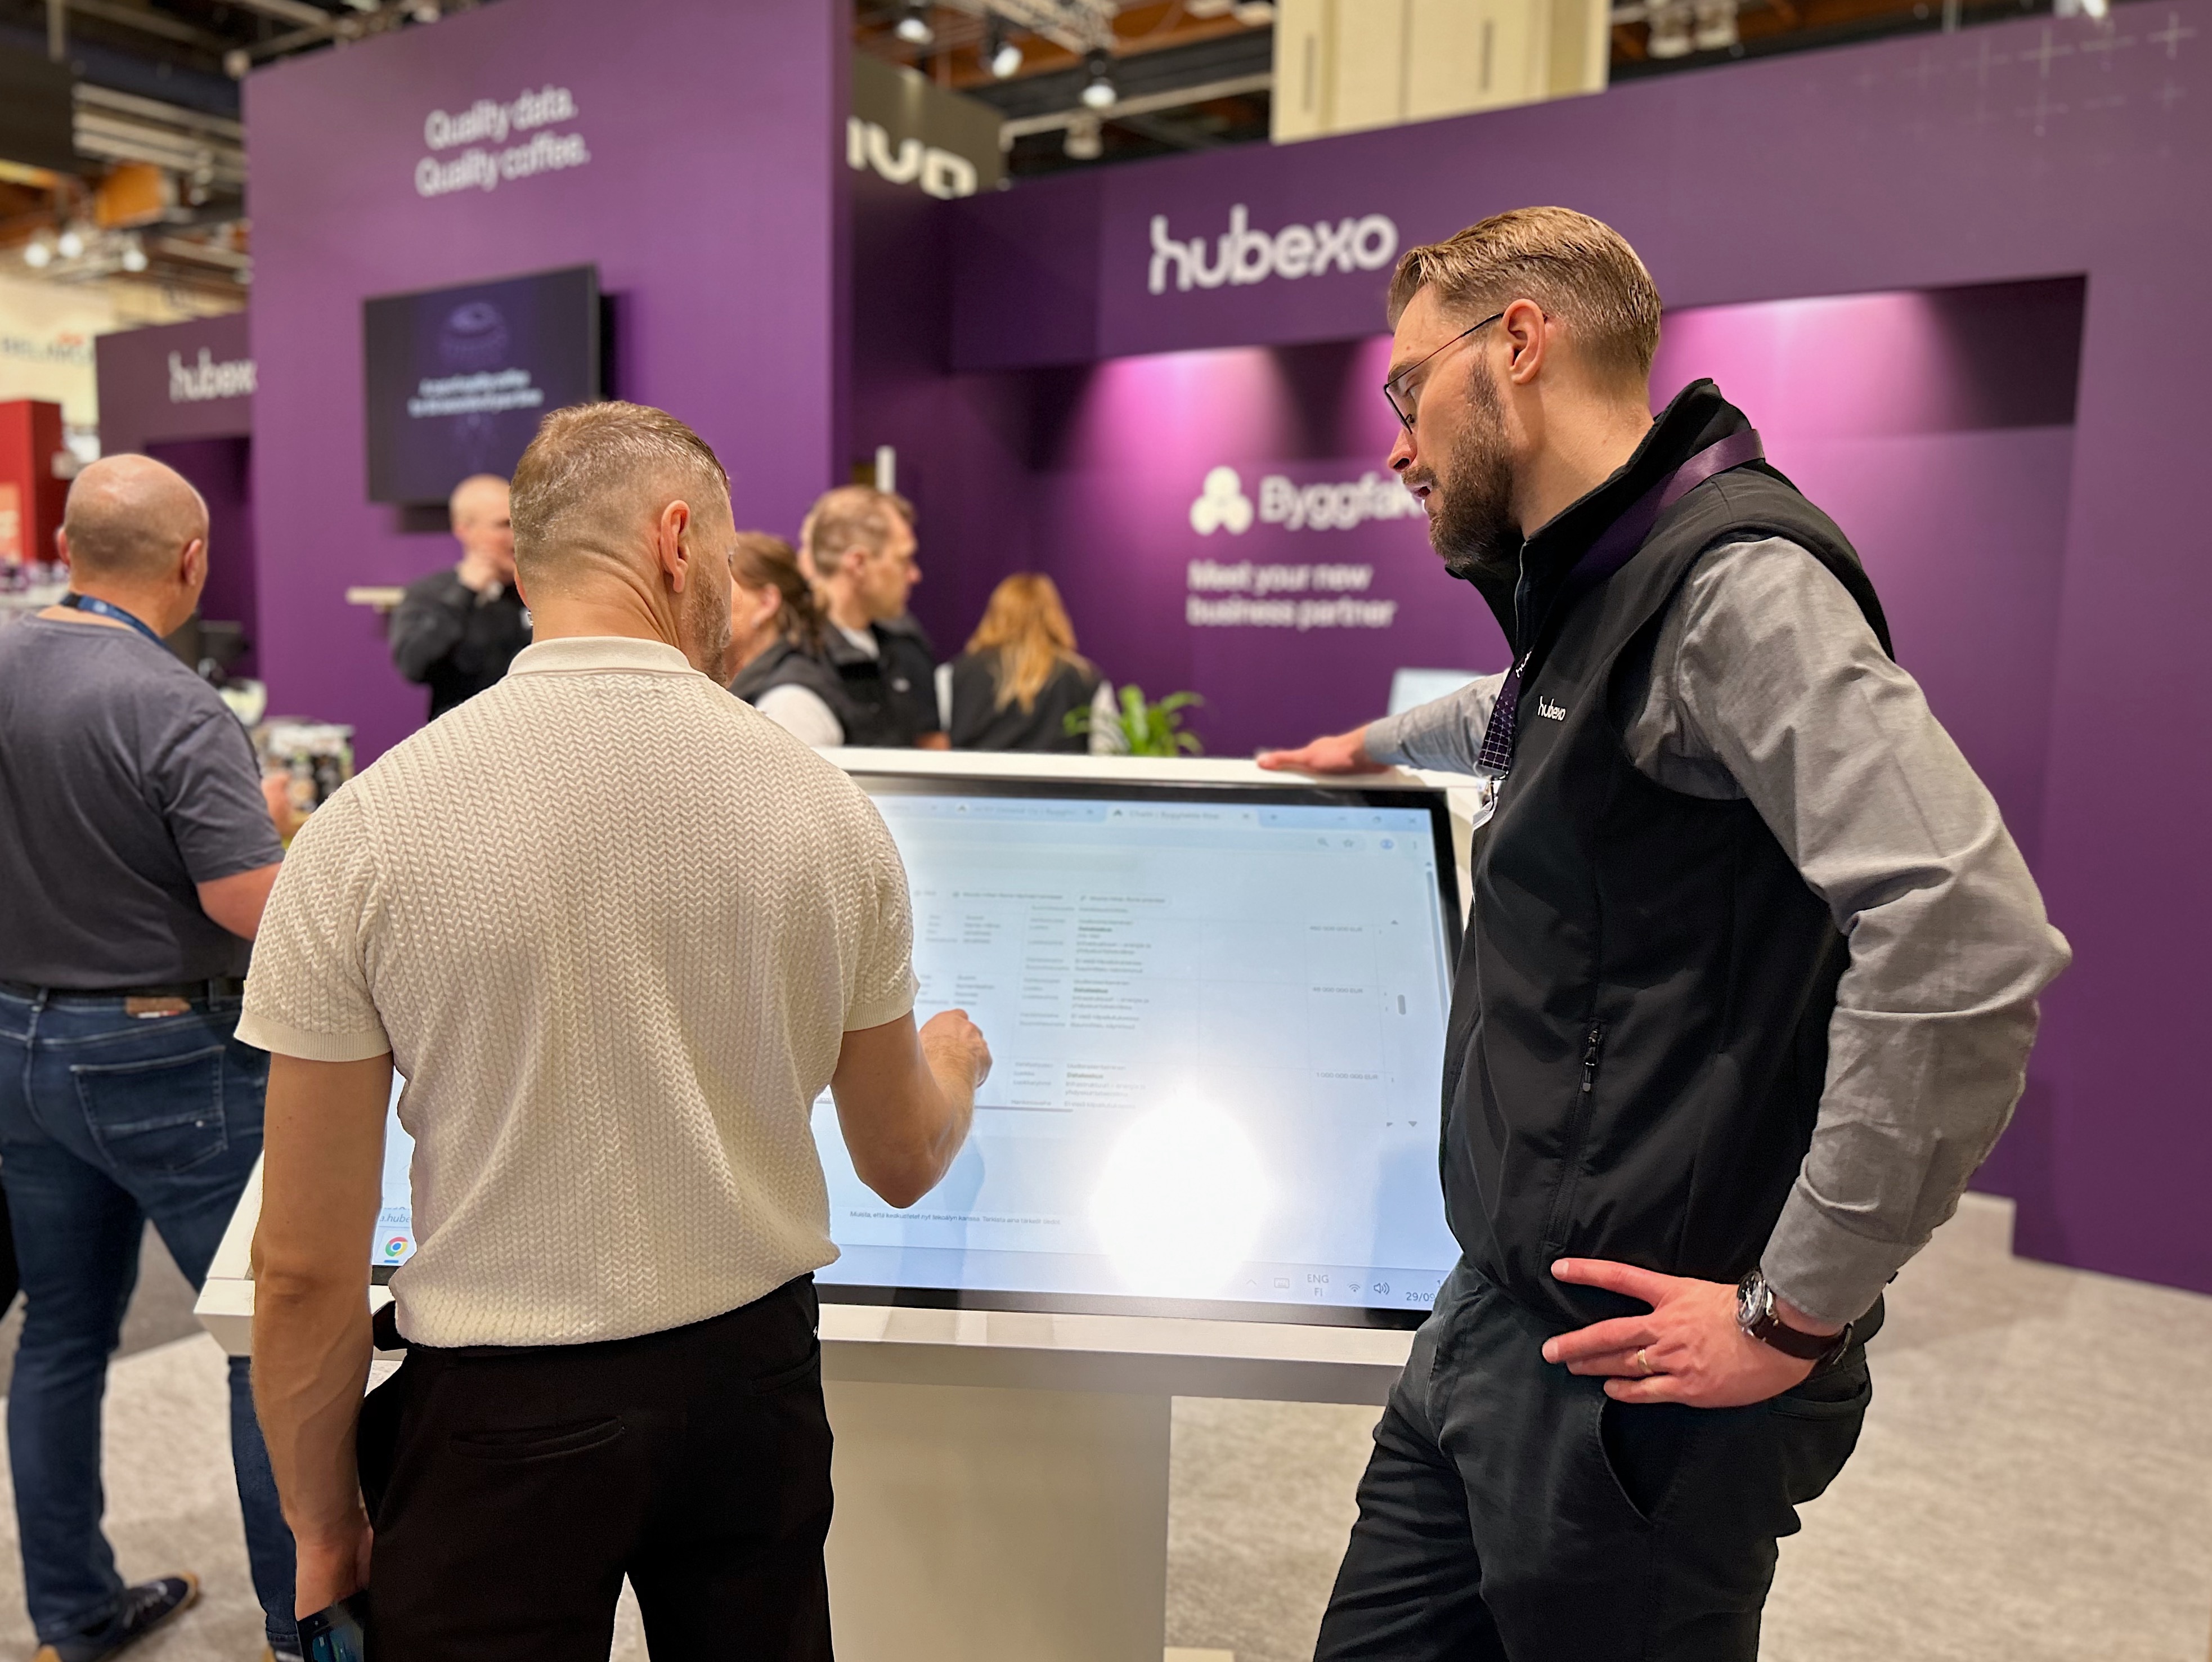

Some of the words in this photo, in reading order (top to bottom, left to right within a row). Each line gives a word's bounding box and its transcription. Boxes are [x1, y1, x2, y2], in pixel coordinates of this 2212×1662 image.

[426, 100, 508, 149] Quality
[415, 148, 498, 197] Quality
[1149, 204, 1398, 295] hubexo
[1254, 565, 1310, 596] your
[1312, 565, 1373, 591] new
[1296, 596, 1397, 632] partner
[1538, 696, 1566, 721] hubexo
[1307, 1274, 1329, 1283] ENG
[1314, 1287, 1322, 1296] FI
